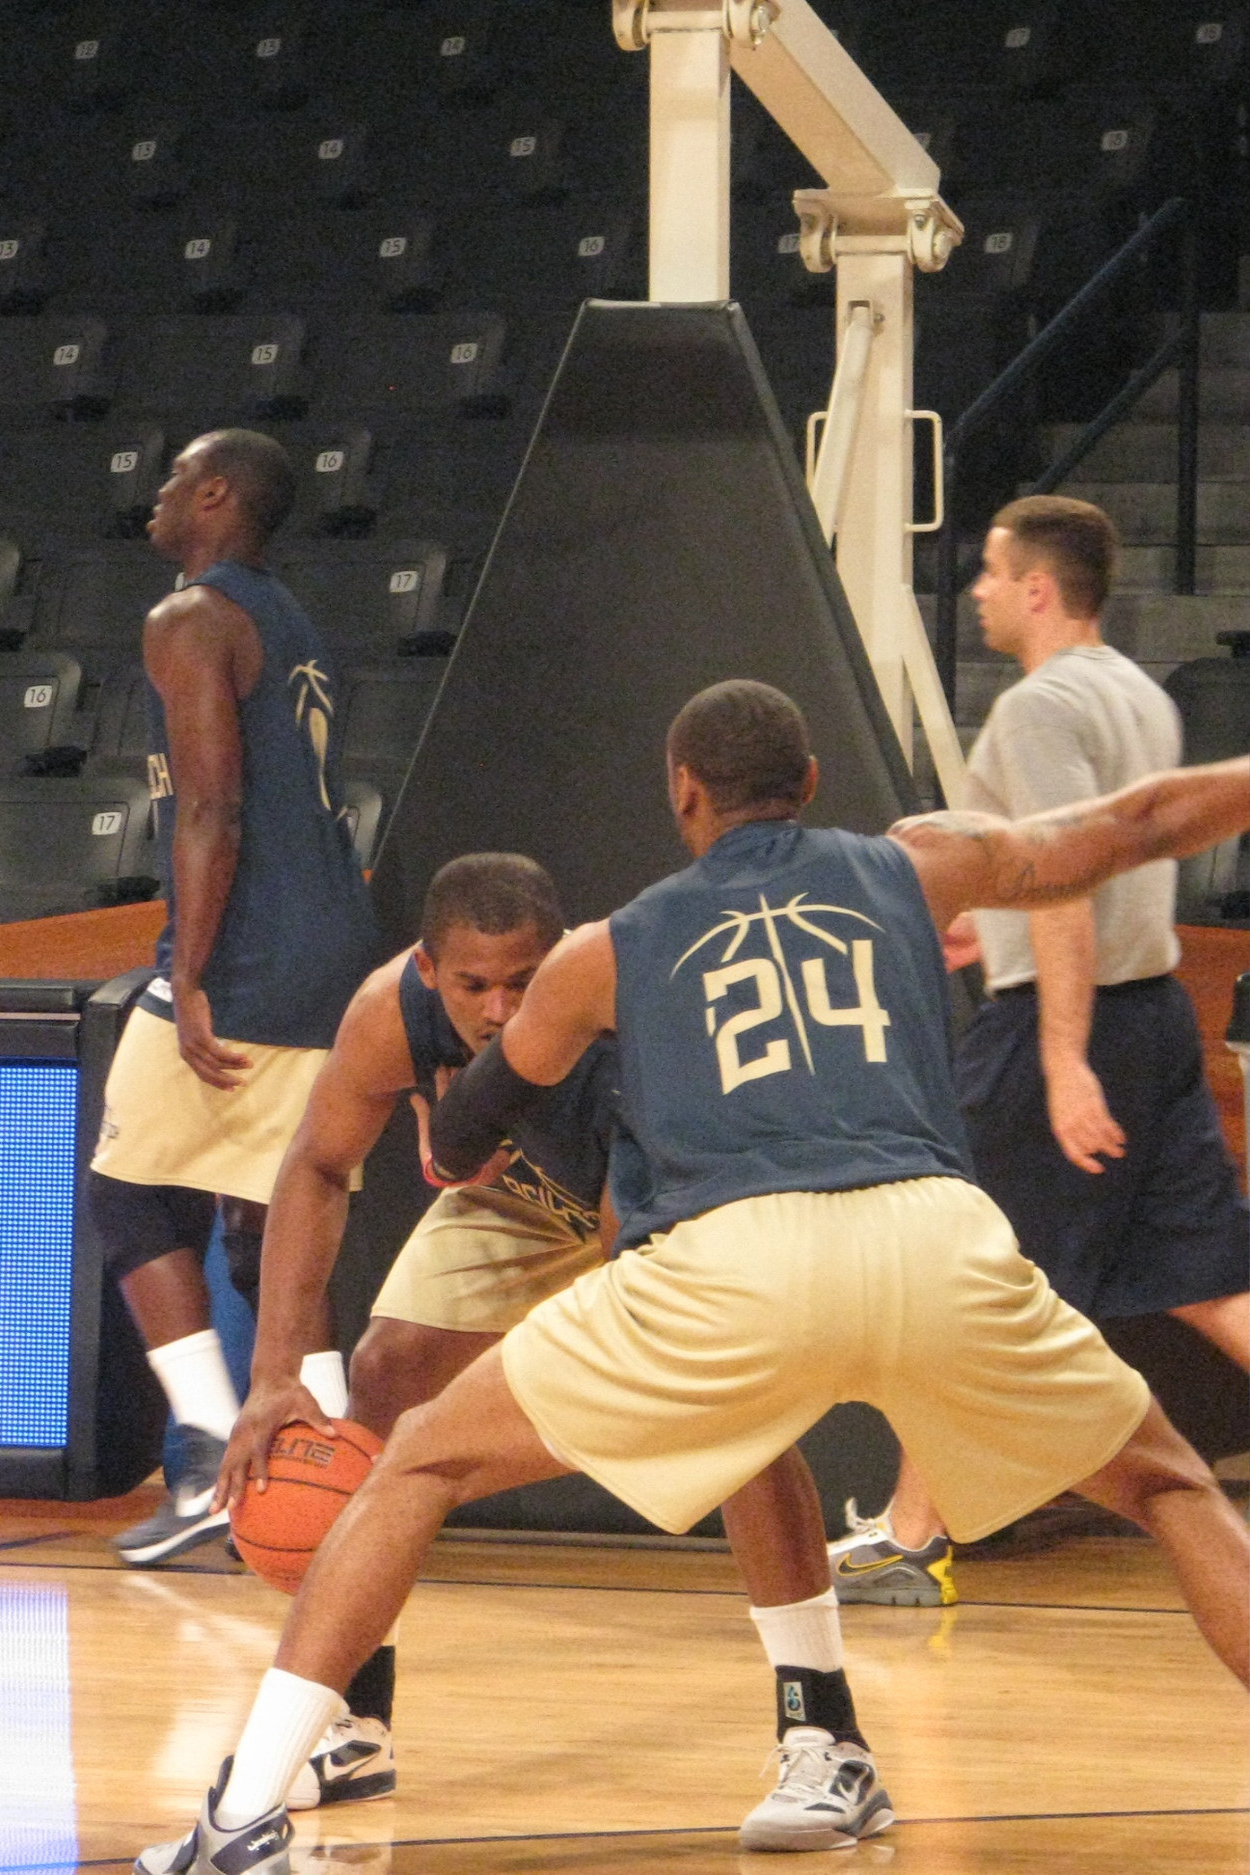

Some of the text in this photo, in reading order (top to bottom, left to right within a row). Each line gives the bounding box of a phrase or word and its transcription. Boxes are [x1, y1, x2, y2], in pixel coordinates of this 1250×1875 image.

[189, 240, 207, 256] 14
[384, 238, 402, 255] 15
[583, 238, 601, 254] 16
[58, 346, 76, 363] 14
[256, 345, 274, 362] 15
[455, 344, 474, 361] 16
[115, 452, 134, 470] 15
[321, 452, 339, 470] 16
[395, 571, 414, 590] 17
[29, 686, 48, 705] 16
[97, 813, 117, 832] 17
[703, 939, 891, 1096] 24
